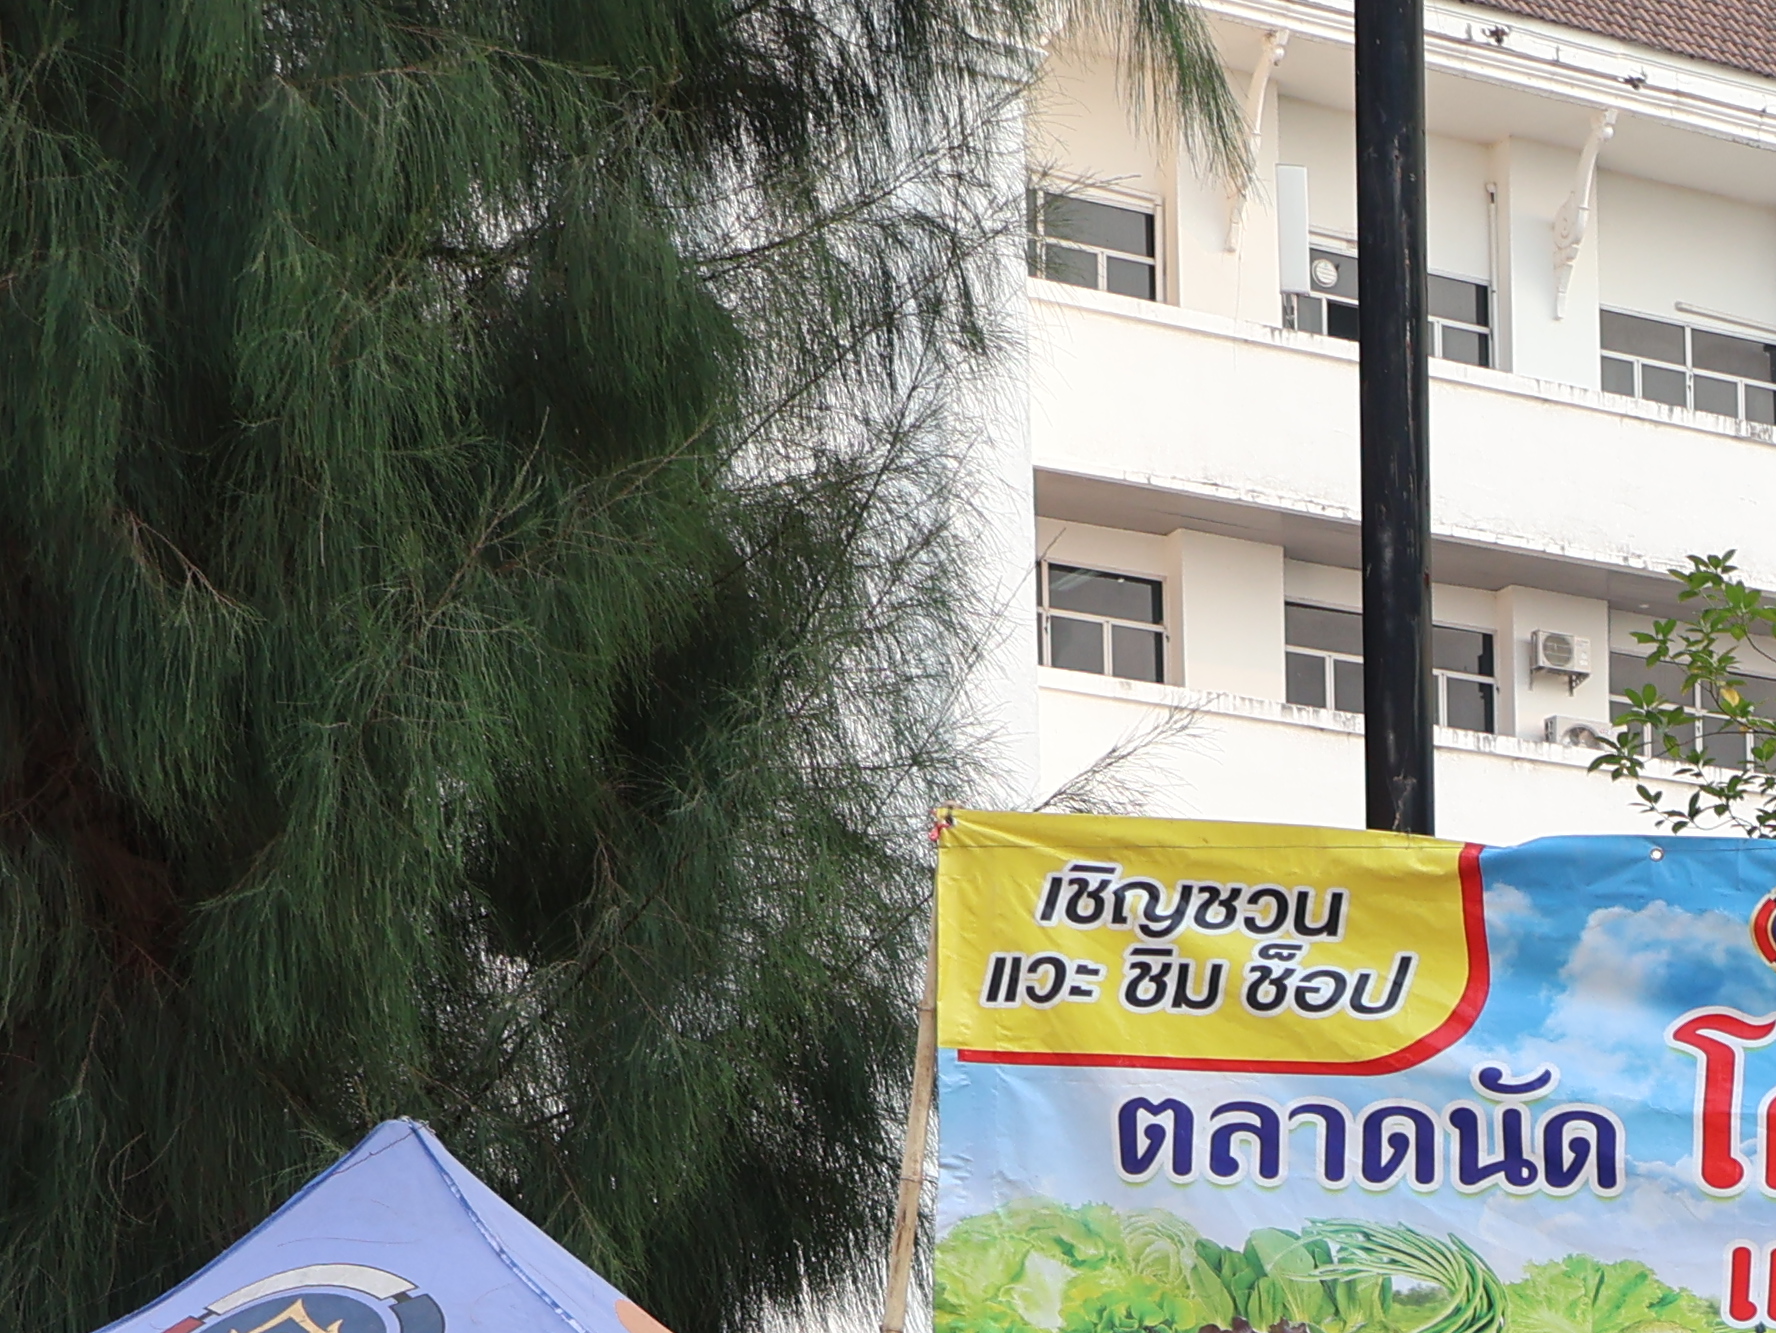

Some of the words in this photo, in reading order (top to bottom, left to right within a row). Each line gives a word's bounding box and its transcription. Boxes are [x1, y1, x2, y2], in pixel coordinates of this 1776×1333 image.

[1038, 863, 1343, 939] เชิญชวน
[984, 952, 1100, 1004] แวะ
[1124, 946, 1223, 1013] ชิม
[1246, 943, 1415, 1016] ช็อป
[1117, 1063, 1624, 1192] ตลาดนัด
